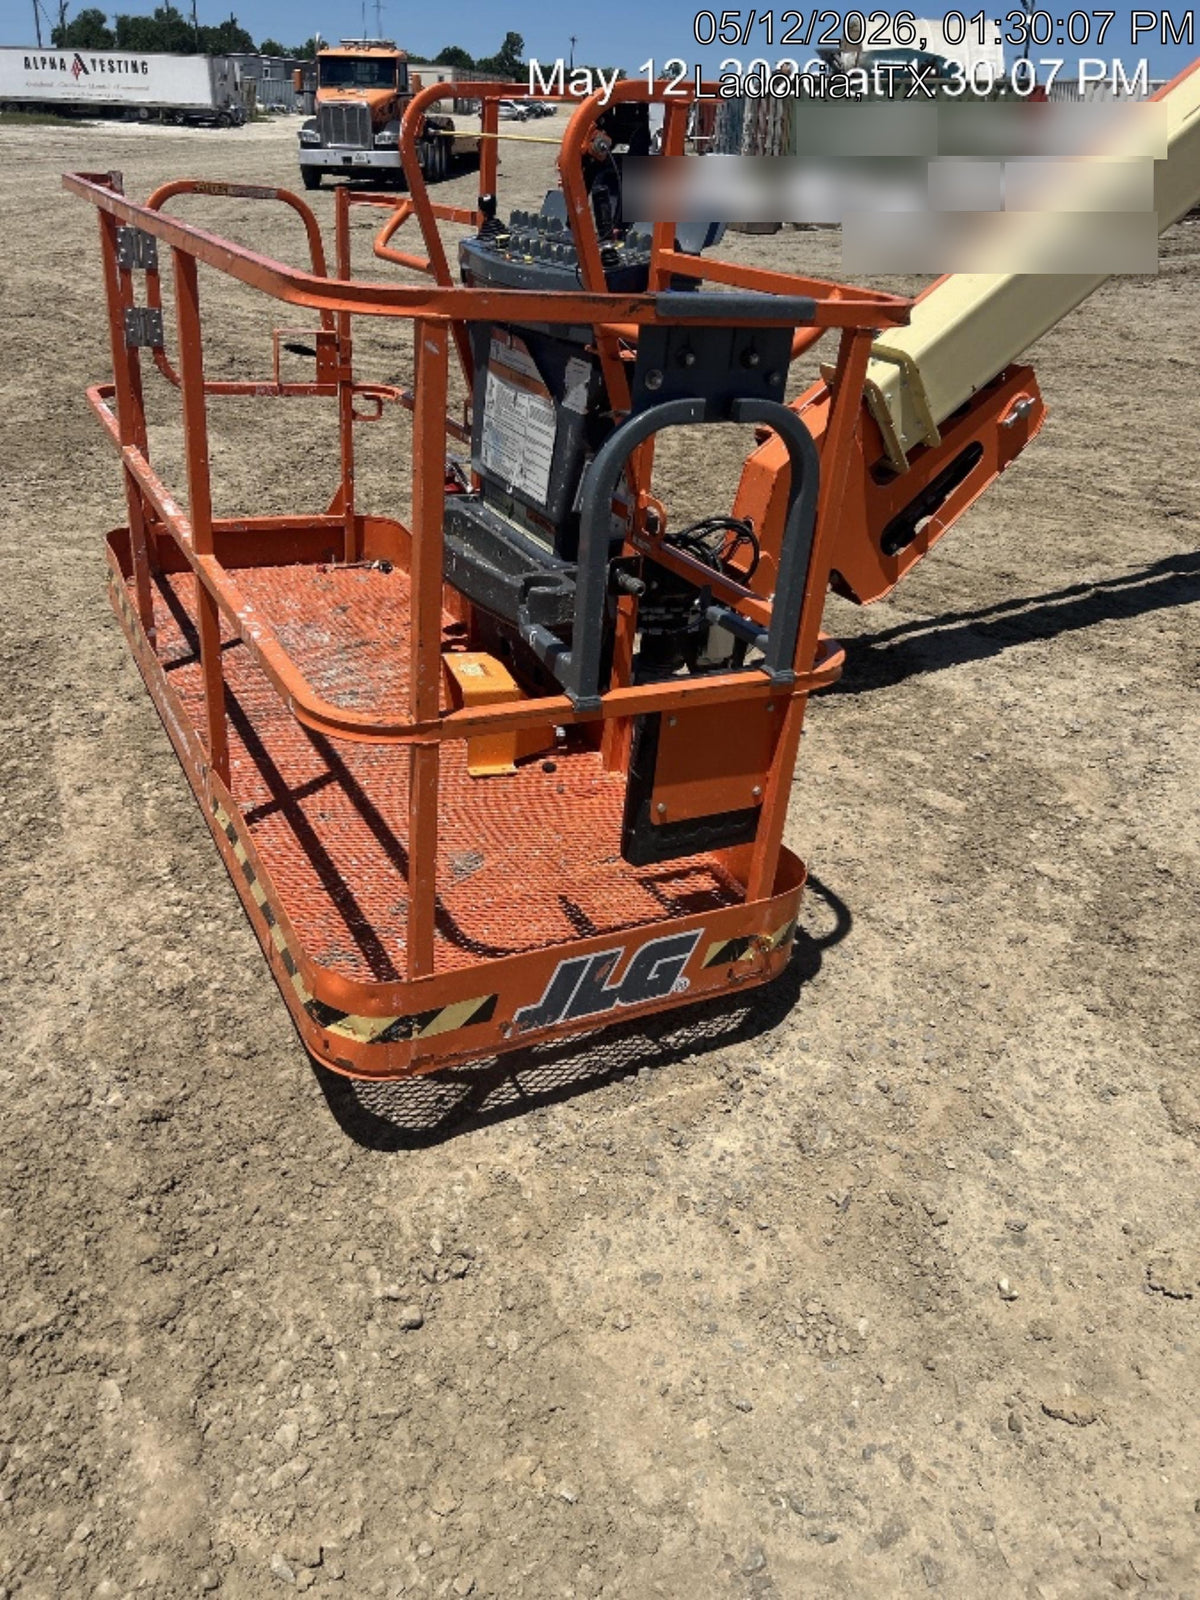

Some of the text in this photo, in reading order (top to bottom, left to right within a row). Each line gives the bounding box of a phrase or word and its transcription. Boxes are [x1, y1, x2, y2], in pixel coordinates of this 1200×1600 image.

[24, 56, 67, 71] ALPHA
[90, 58, 149, 75] TESTING
[504, 927, 706, 1039] JLG
